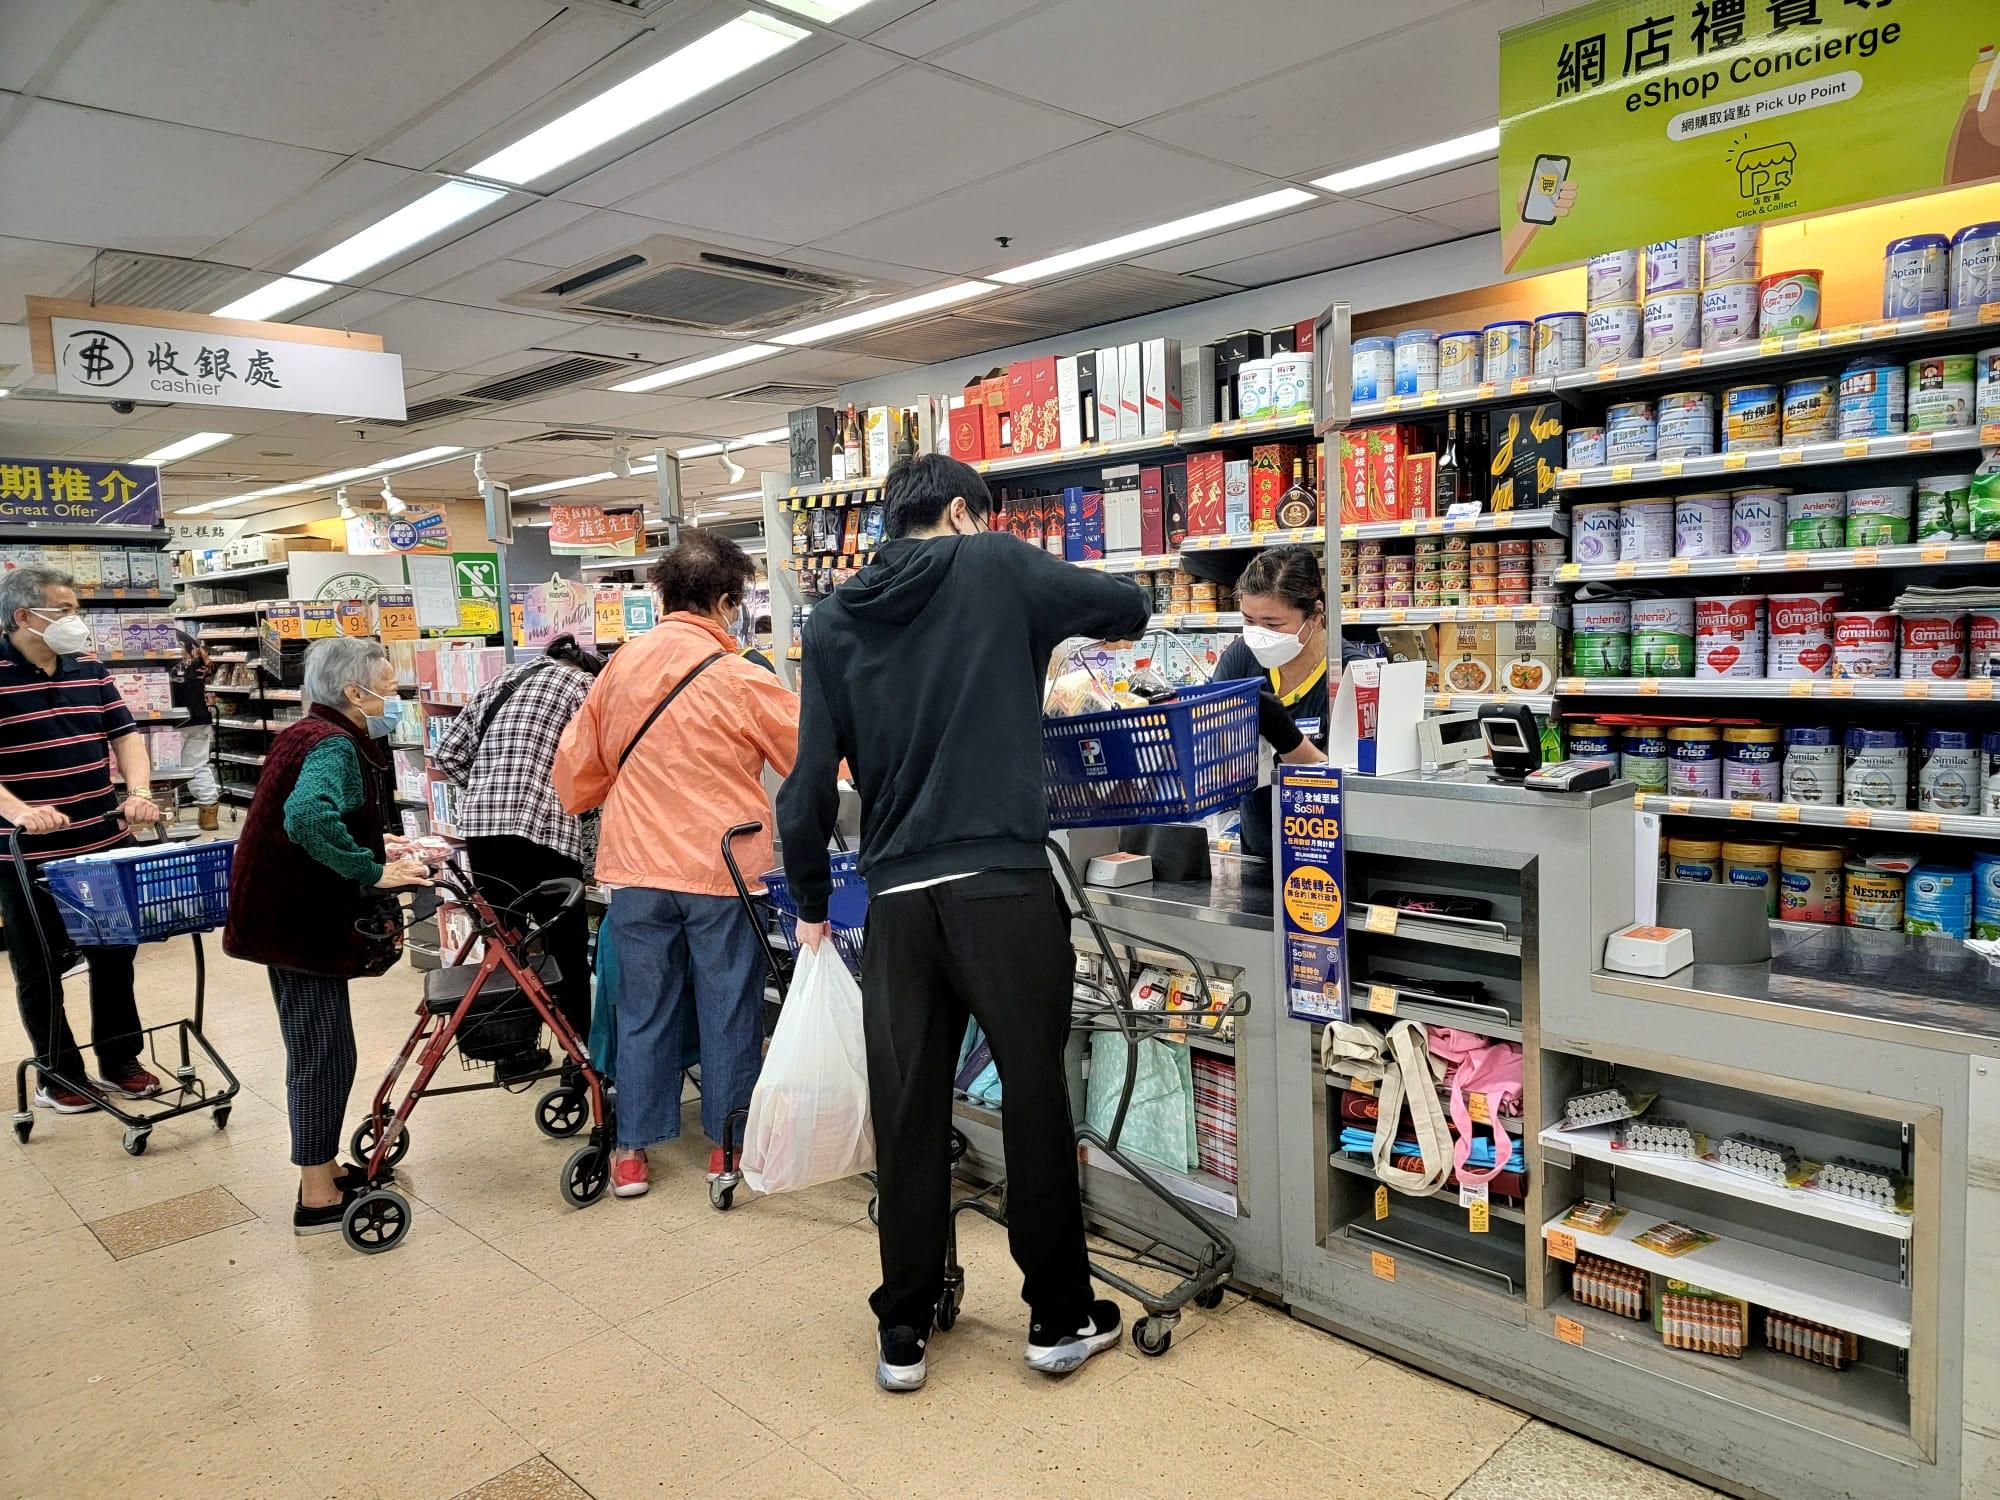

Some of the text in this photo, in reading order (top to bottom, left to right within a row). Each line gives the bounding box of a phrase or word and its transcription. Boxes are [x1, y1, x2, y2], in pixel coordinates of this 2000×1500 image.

[1556, 0, 1894, 97] 網店禮賓
[1625, 22, 1902, 113] eShop Concierge
[1755, 81, 1847, 113] Pick Up Point
[1680, 104, 1751, 133] 網購取貨點
[1736, 200, 1798, 219] Click & Collect
[1891, 264, 1932, 280] Aptamil
[1732, 327, 1739, 335] 4
[147, 341, 283, 389] 收銀處
[1510, 364, 1517, 373] 3
[150, 377, 221, 396] cashier
[1402, 380, 1409, 390] 3
[1742, 403, 1776, 421] 怡保康
[1787, 397, 1822, 417] 怡保康
[1803, 501, 1836, 511] Anlene
[1850, 498, 1881, 508] Anlene
[0, 502, 99, 517] Great Offer
[1734, 506, 1771, 520] NAN
[1584, 518, 1620, 531] NAN
[1696, 532, 1704, 543] 3
[1763, 528, 1771, 539] 3
[1629, 536, 1636, 547] 2
[528, 626, 550, 641] mix
[561, 602, 592, 630] match
[1585, 615, 1621, 625] Anlene
[1633, 612, 1666, 622] Anlene
[1776, 609, 1833, 629] Carnatio
[1837, 625, 1890, 642] Carnation
[1639, 744, 1666, 754] Friso
[1676, 746, 1706, 757] Friso
[1739, 749, 1770, 759] Friso
[1788, 751, 1821, 761] Similac
[1860, 756, 1894, 765] Similac
[1932, 755, 1969, 765] Similac
[1294, 803, 1325, 814] SoSIM
[1284, 816, 1339, 839] 50GB
[1804, 911, 1812, 921] 5
[1292, 948, 1317, 960] SoSIM
[1666, 1278, 1688, 1290] GP
